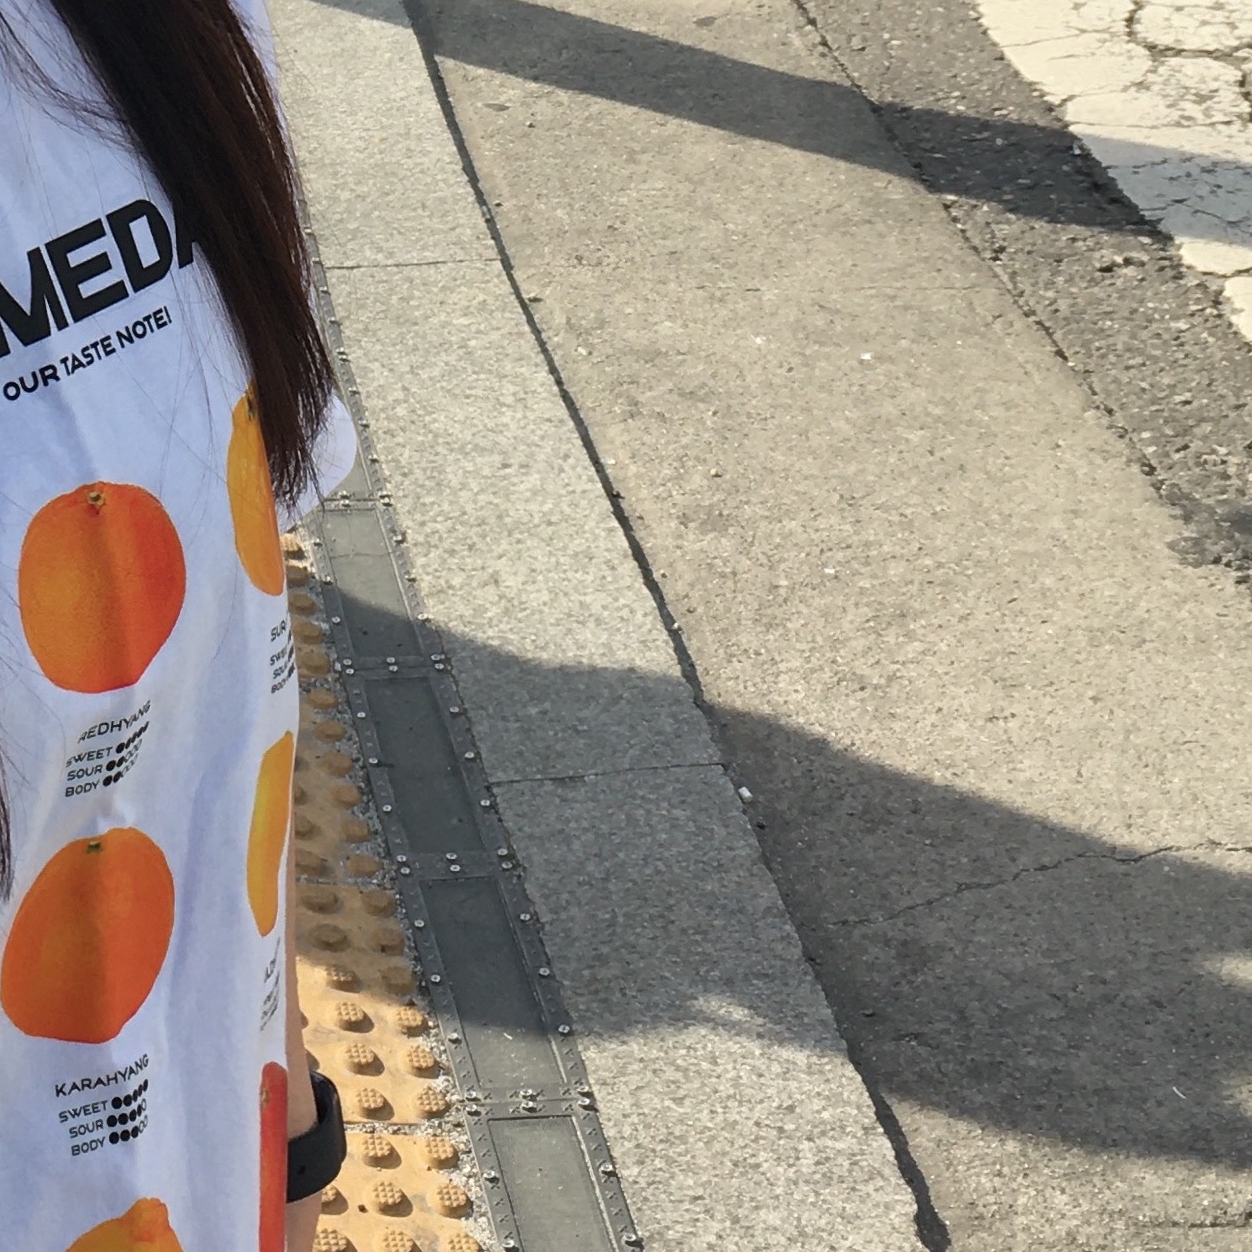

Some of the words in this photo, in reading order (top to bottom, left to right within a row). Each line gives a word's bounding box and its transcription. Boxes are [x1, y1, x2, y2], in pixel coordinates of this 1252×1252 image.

[2, 364, 60, 402] OUR
[60, 335, 117, 377] TASTE
[116, 306, 172, 350] NOTE!
[77, 699, 150, 744] REDHYANG
[65, 746, 113, 768] SWEET
[67, 764, 102, 781] SOUR
[65, 779, 100, 797] BODY
[55, 1053, 149, 1097] KARAHYANG
[58, 1100, 108, 1123] SWEET
[69, 1119, 103, 1139] SOUR
[71, 1136, 106, 1156] BODY
